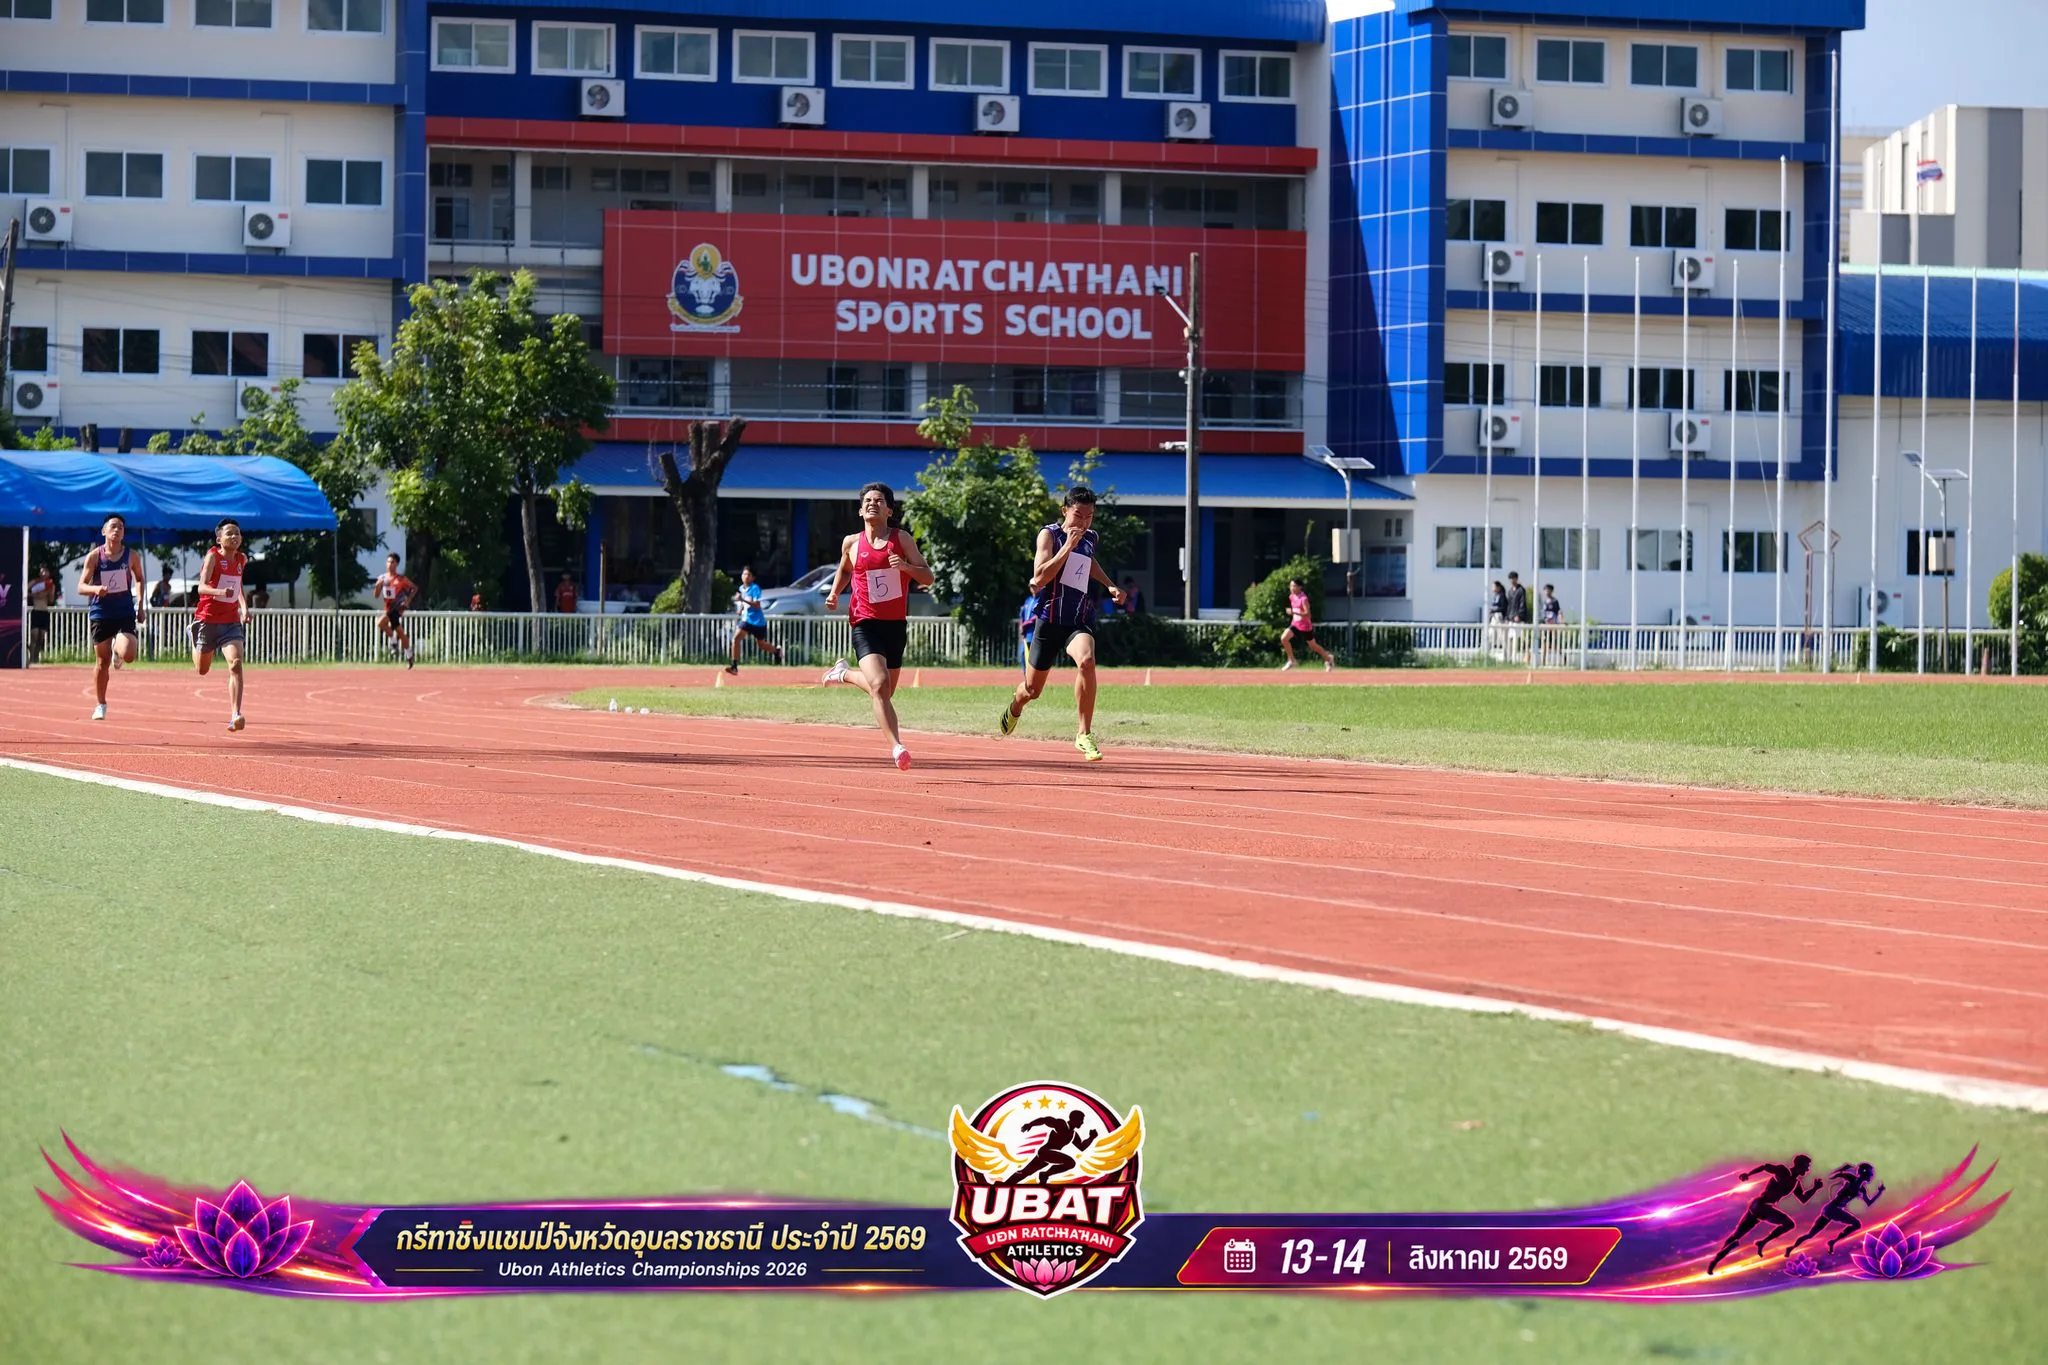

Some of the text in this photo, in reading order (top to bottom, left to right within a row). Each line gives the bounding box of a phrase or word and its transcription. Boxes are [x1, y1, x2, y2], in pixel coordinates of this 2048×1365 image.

[791, 253, 1183, 297] UBONRATCHATHANI
[835, 299, 1153, 340] SPORTS SCHOOL
[875, 575, 889, 598] 5
[1074, 563, 1084, 581] 4
